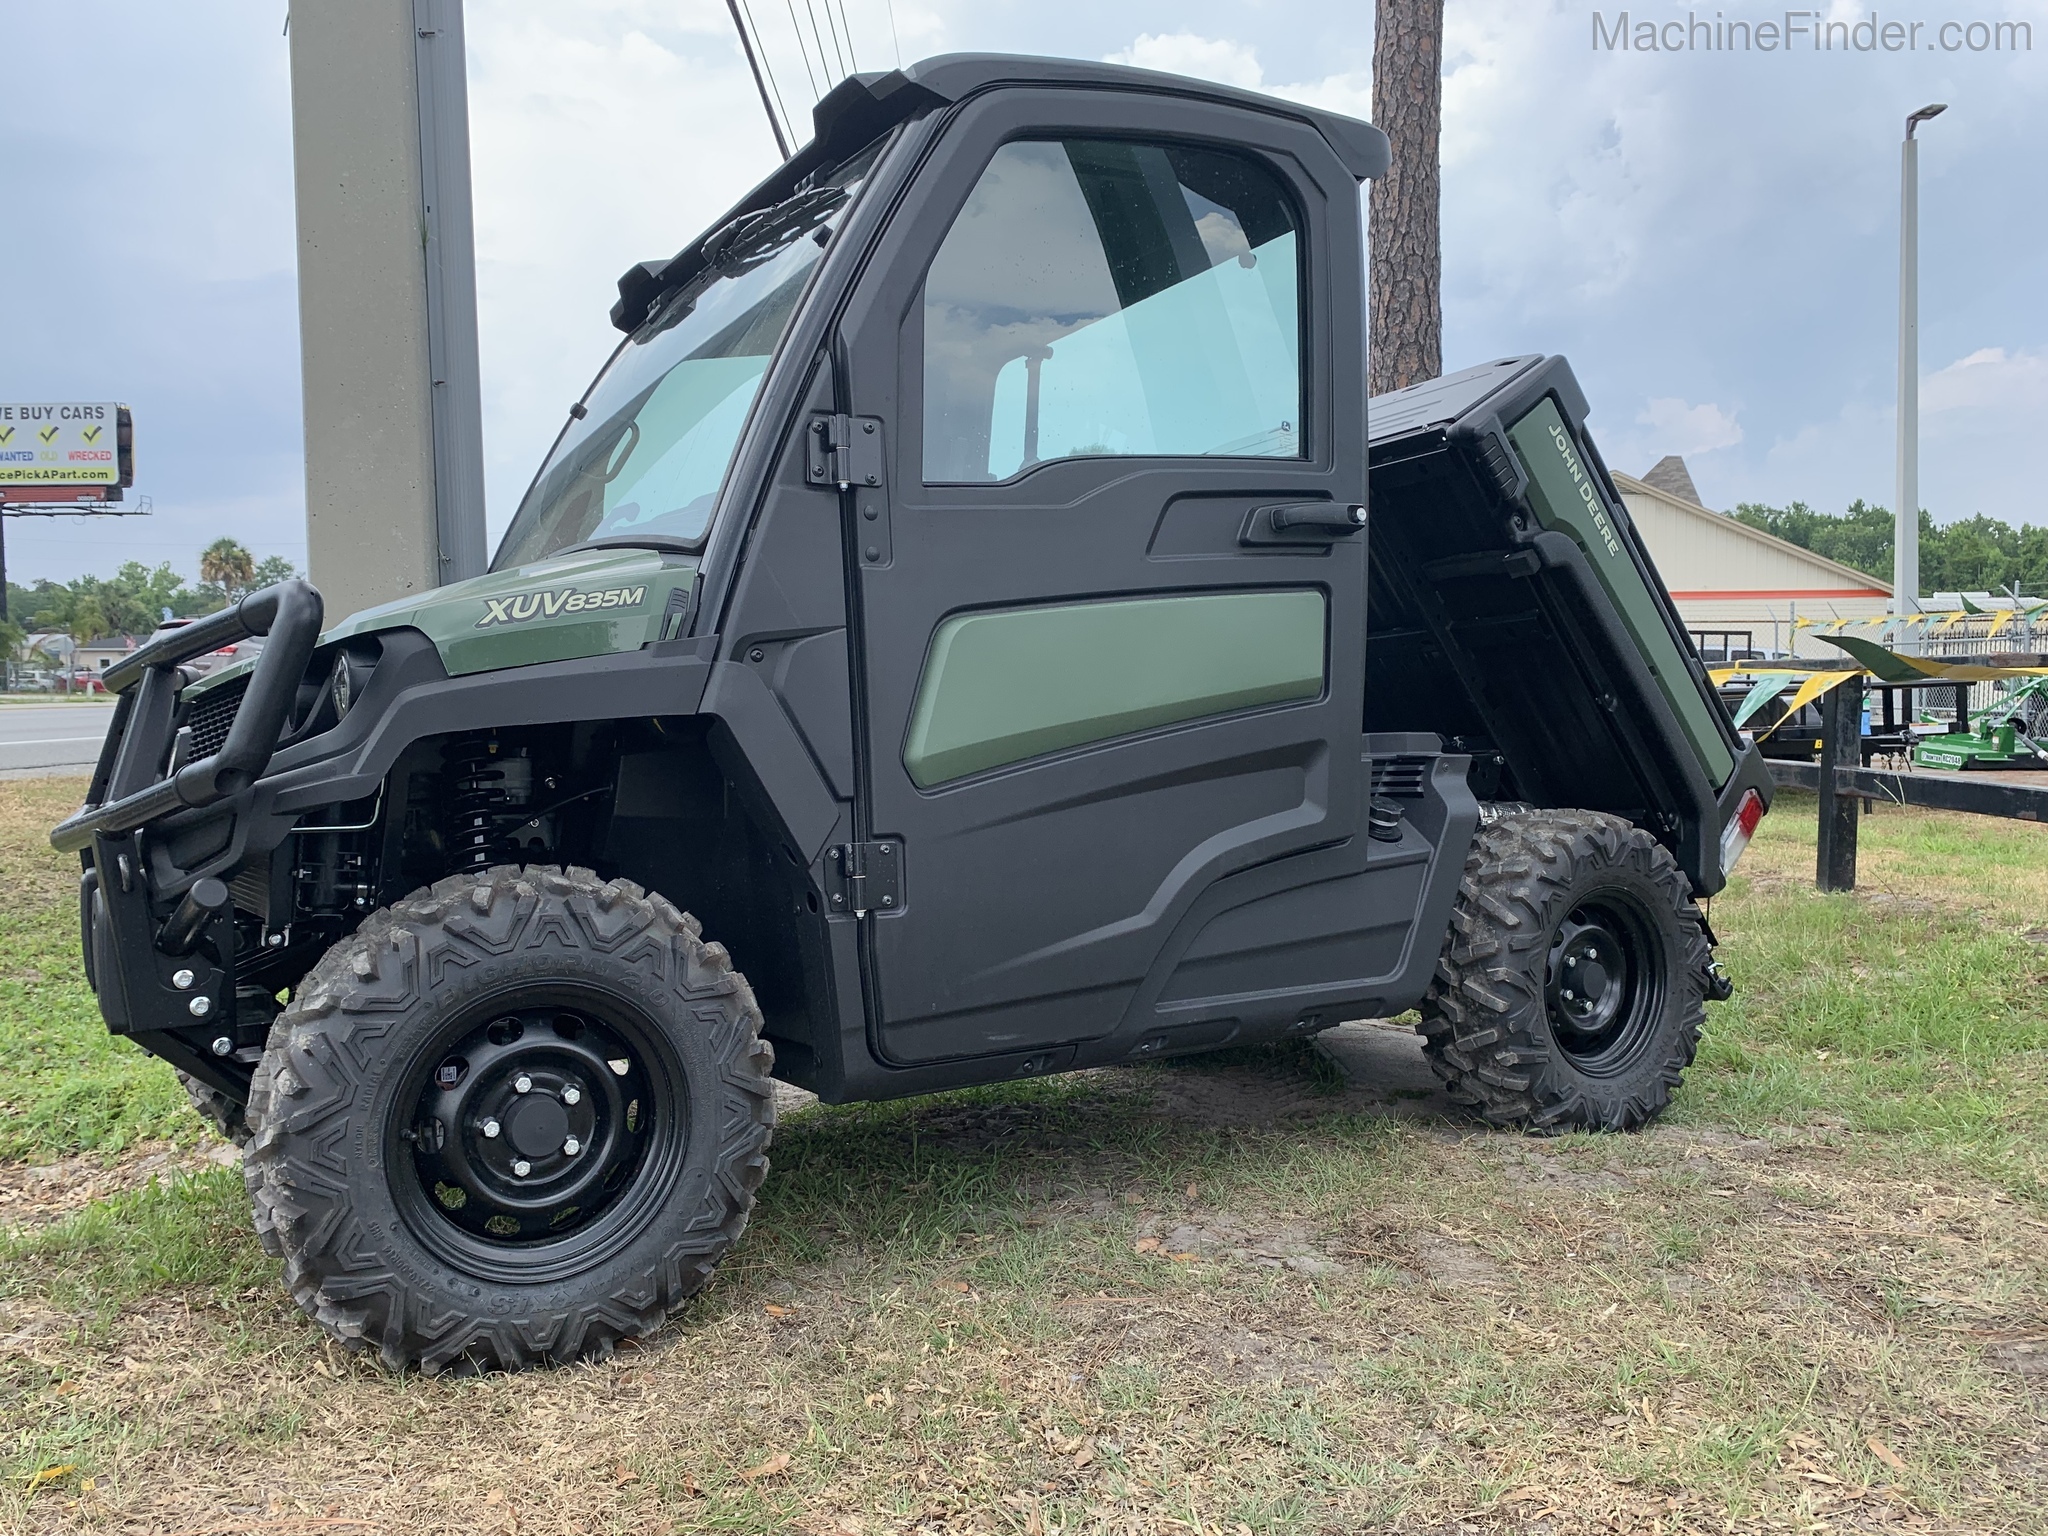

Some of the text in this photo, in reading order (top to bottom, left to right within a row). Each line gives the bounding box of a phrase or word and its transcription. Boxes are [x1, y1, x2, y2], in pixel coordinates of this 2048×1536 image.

[20, 407, 53, 420] BUY
[60, 406, 104, 420] CARS
[40, 452, 58, 461] OLD
[68, 451, 112, 461] WRECKED
[1549, 425, 1619, 557] JOHN DEERE
[478, 587, 647, 627] XUV835M
[433, 953, 614, 1010] BIGHORN
[617, 969, 671, 1009] 2.0
[360, 1071, 382, 1112] RADIAL
